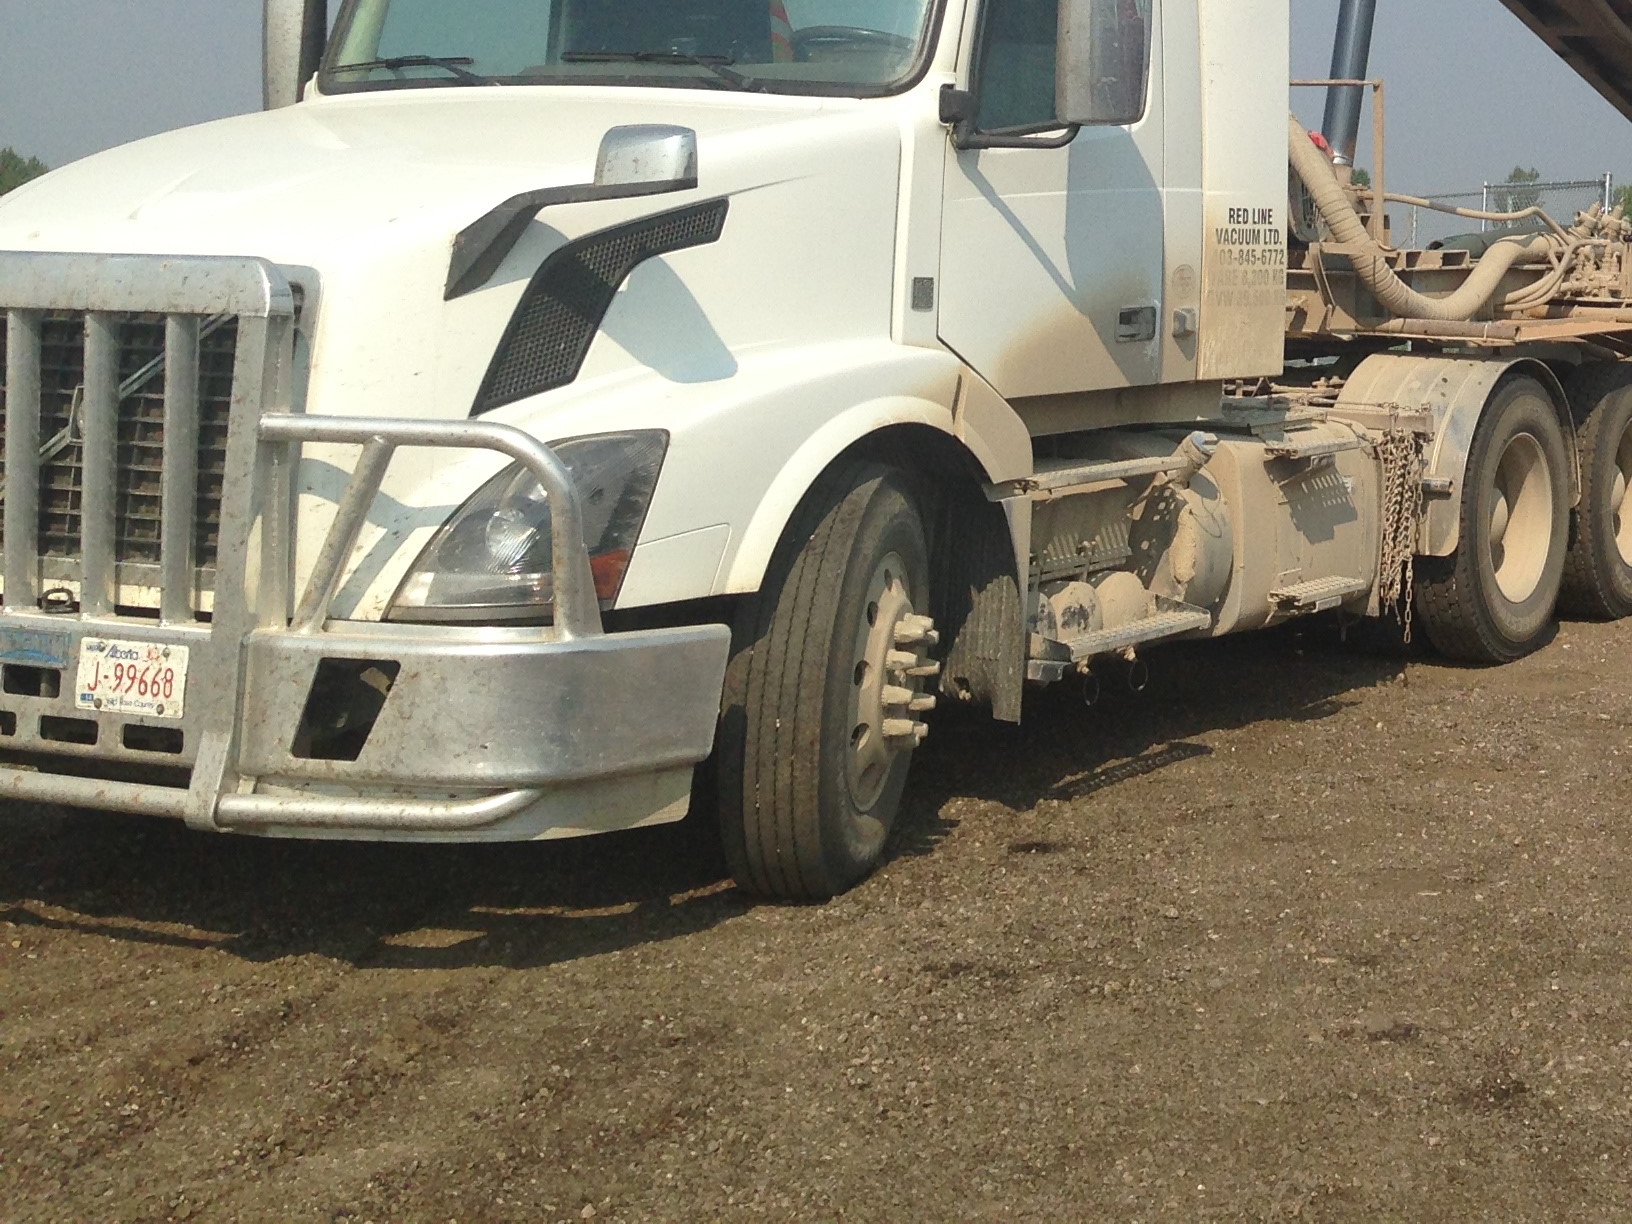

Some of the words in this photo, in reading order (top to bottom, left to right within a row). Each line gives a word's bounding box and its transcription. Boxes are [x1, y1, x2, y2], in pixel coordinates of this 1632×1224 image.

[1228, 207, 1249, 225] RED
[1252, 208, 1273, 225] LINE
[1215, 227, 1260, 245] VACUUM
[1263, 228, 1282, 245] LTD.
[104, 643, 139, 661] Alberta
[87, 661, 175, 699] J-99668
